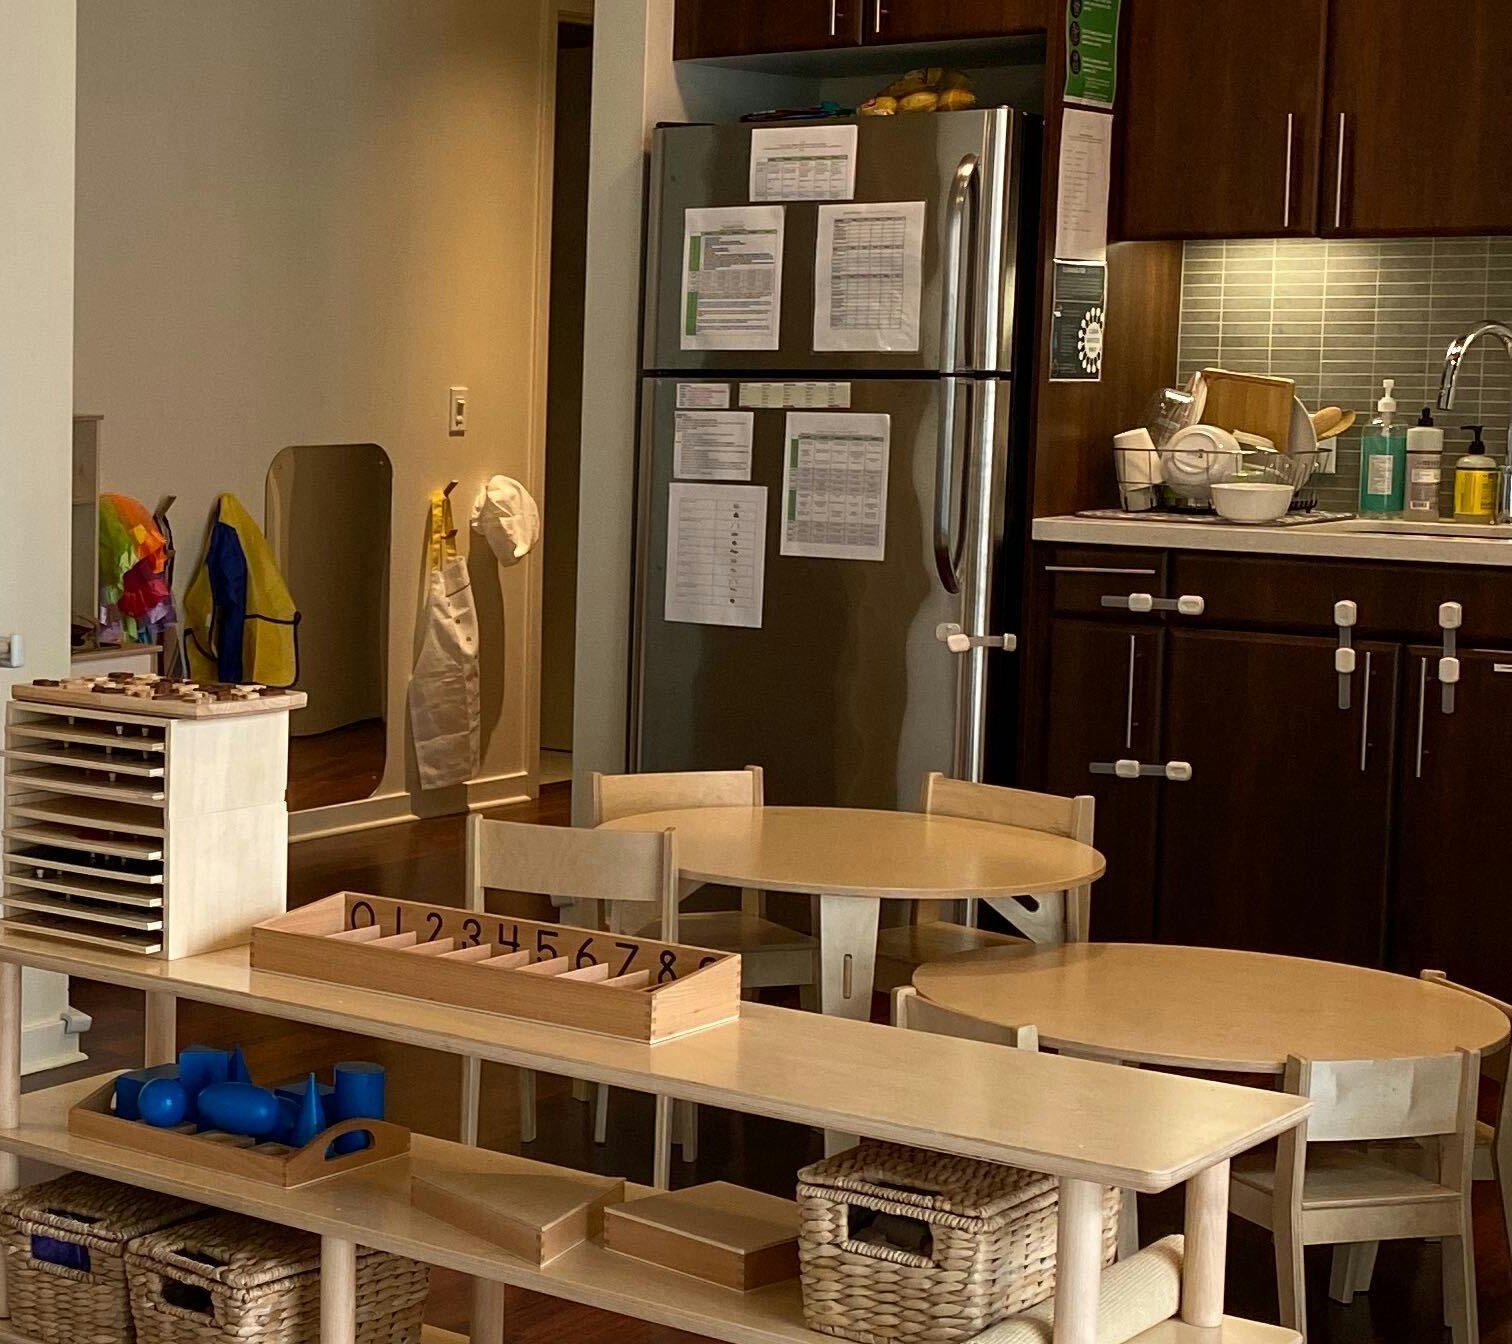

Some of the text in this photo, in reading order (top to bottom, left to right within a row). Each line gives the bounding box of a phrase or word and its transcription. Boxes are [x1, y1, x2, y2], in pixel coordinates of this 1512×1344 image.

[426, 912, 443, 942] 2
[461, 918, 481, 950] 3
[498, 923, 521, 953] 4
[536, 930, 558, 962] 5
[576, 938, 597, 969] 6
[615, 942, 639, 977] 7
[657, 949, 677, 983] 8
